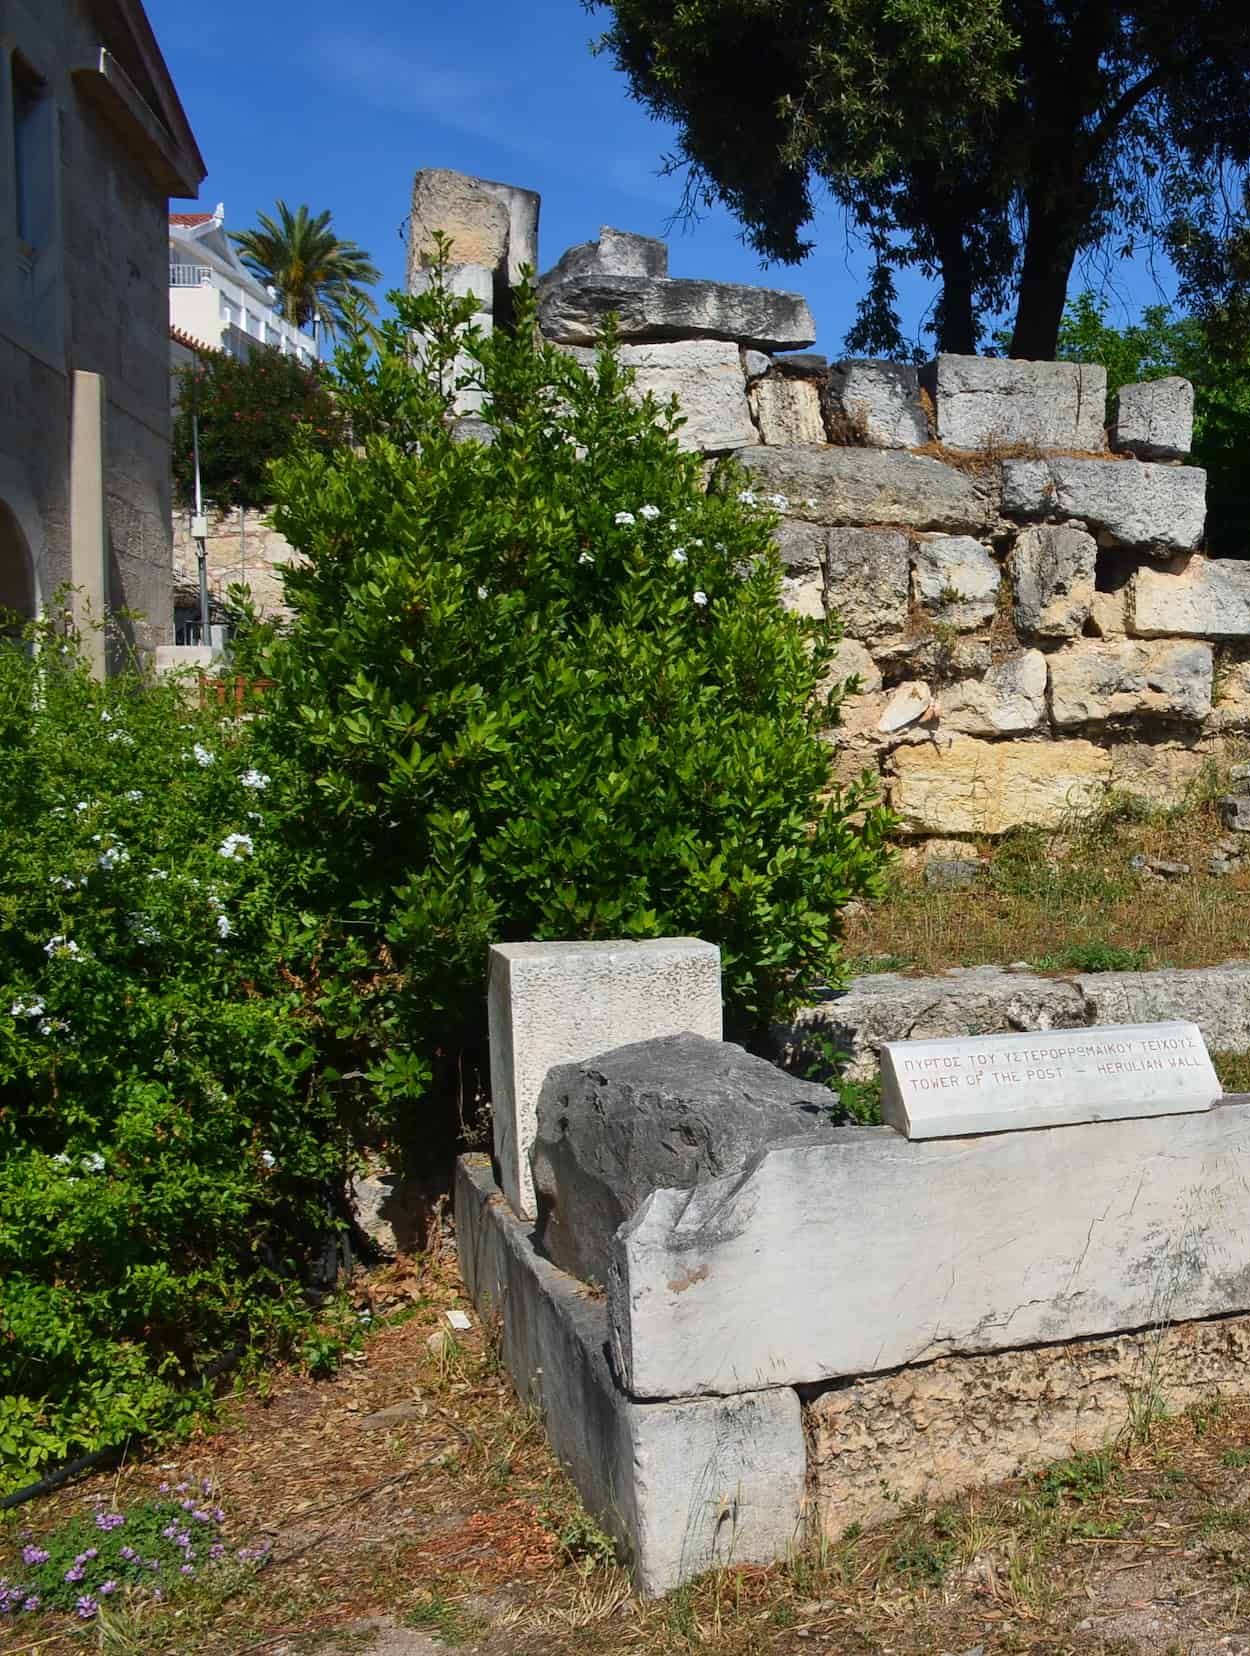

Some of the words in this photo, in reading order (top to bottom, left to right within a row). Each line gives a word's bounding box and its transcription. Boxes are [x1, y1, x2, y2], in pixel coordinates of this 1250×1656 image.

[904, 1056, 961, 1071] ΠΥΡΓΟΣ
[968, 1054, 995, 1066] ΤΟΥ
[1140, 1038, 1197, 1052] ΤΕΙΧΟΥΣ
[910, 1075, 960, 1091] TOWER
[966, 1073, 983, 1087] OF
[992, 1071, 1021, 1085] THE
[1027, 1067, 1064, 1081] POST
[1097, 1058, 1163, 1073] HERULIAN
[1167, 1056, 1202, 1068] WALL
